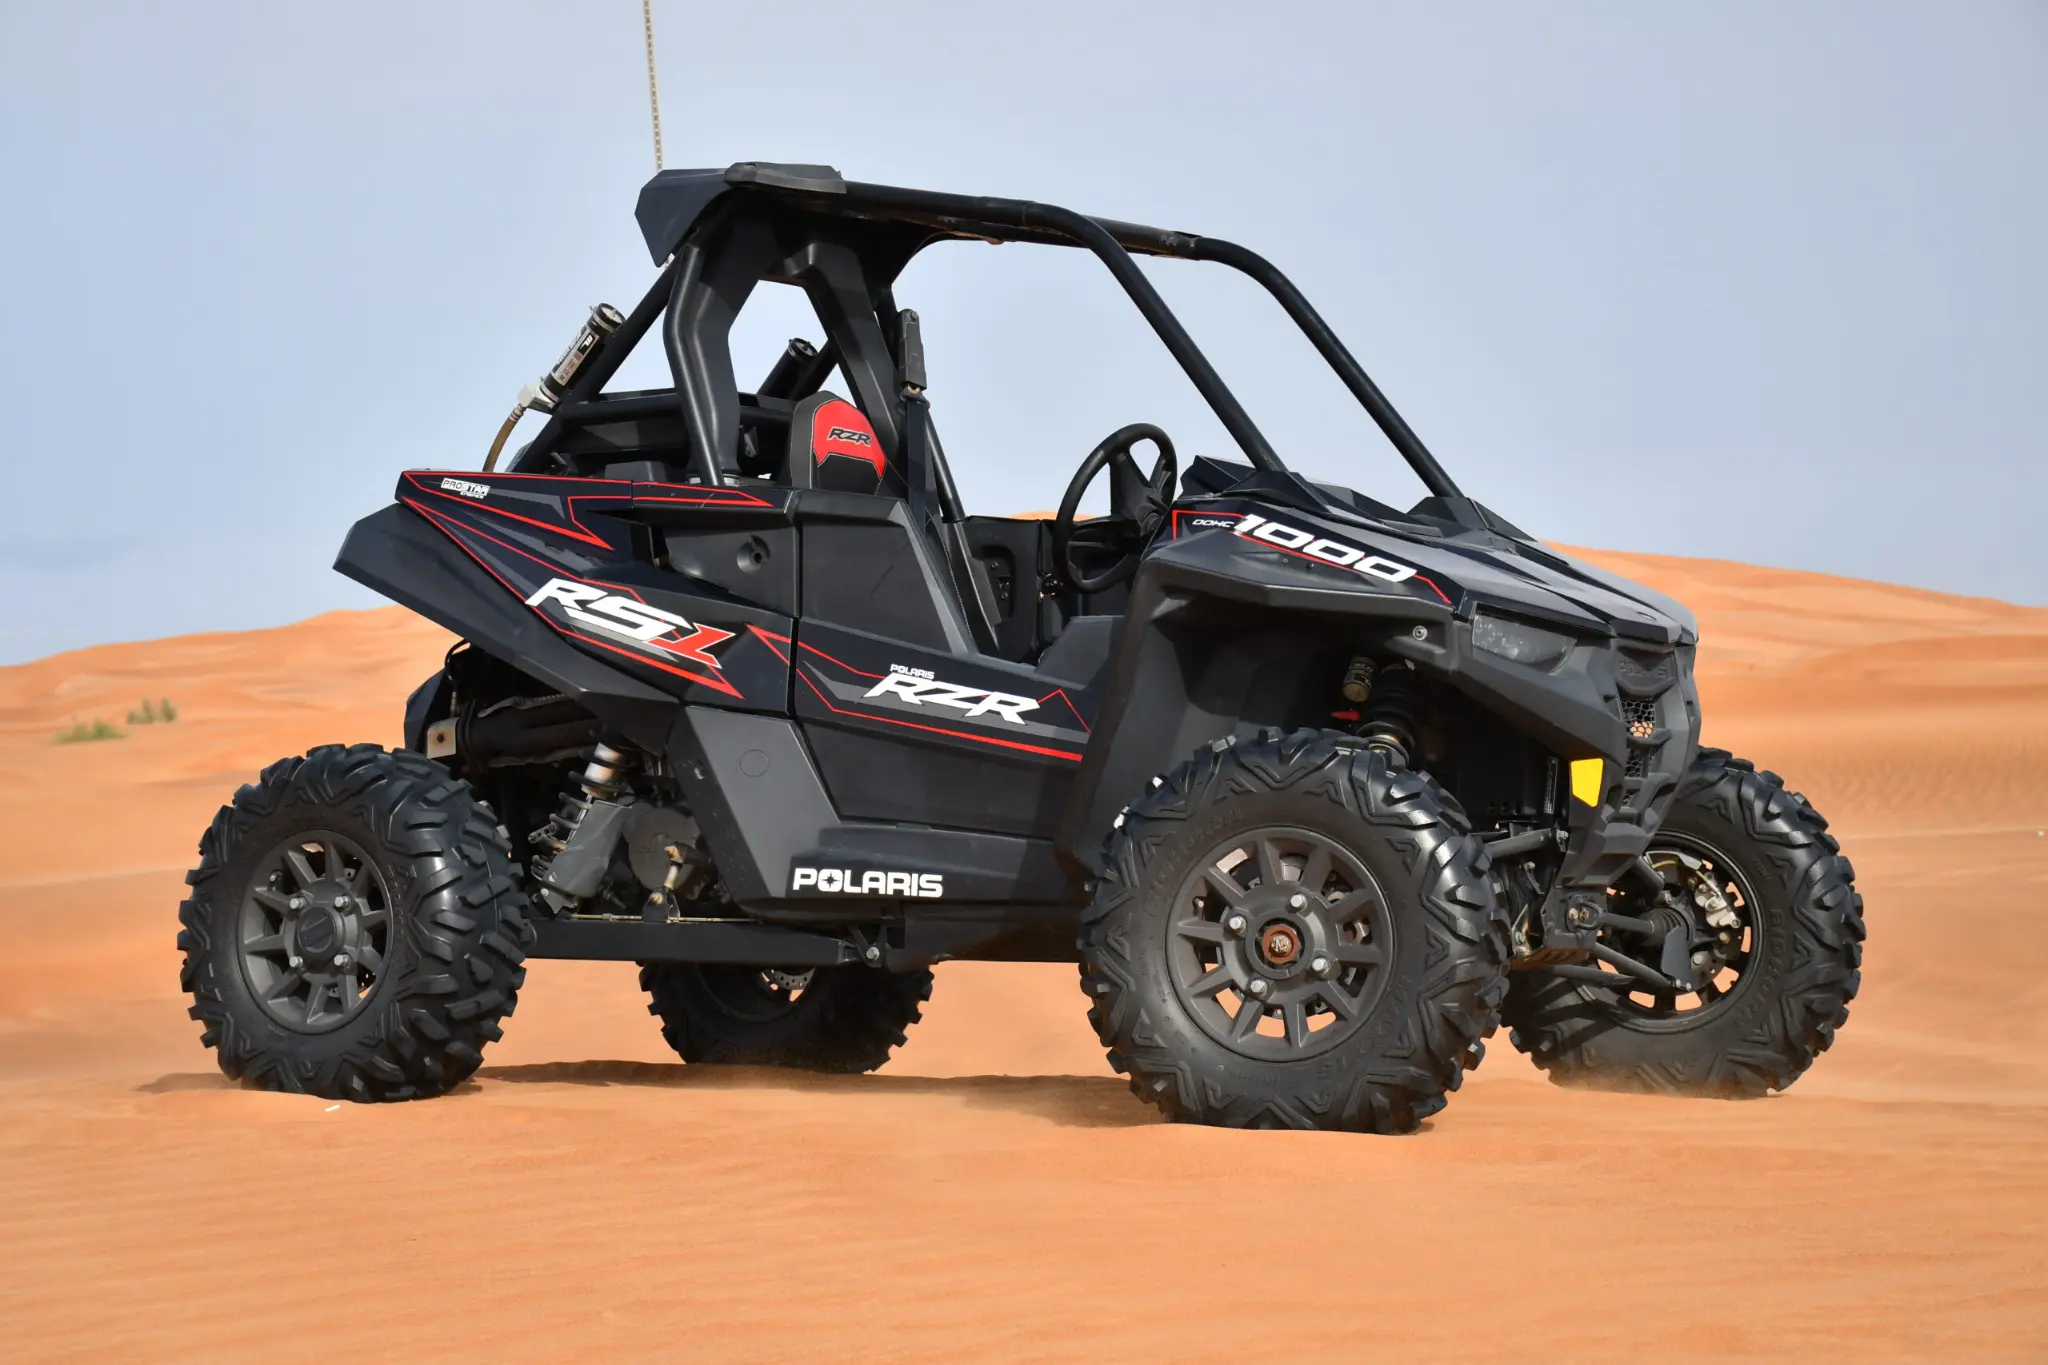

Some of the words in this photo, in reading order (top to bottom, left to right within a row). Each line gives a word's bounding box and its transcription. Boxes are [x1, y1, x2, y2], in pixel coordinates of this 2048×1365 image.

[827, 427, 871, 447] RZR
[1192, 518, 1234, 529] DOHC
[1234, 513, 1417, 583] 1000
[525, 577, 735, 669] RS1
[890, 664, 935, 680] POLARIS
[863, 672, 1040, 725] RZR
[792, 868, 943, 898] POLARIS
